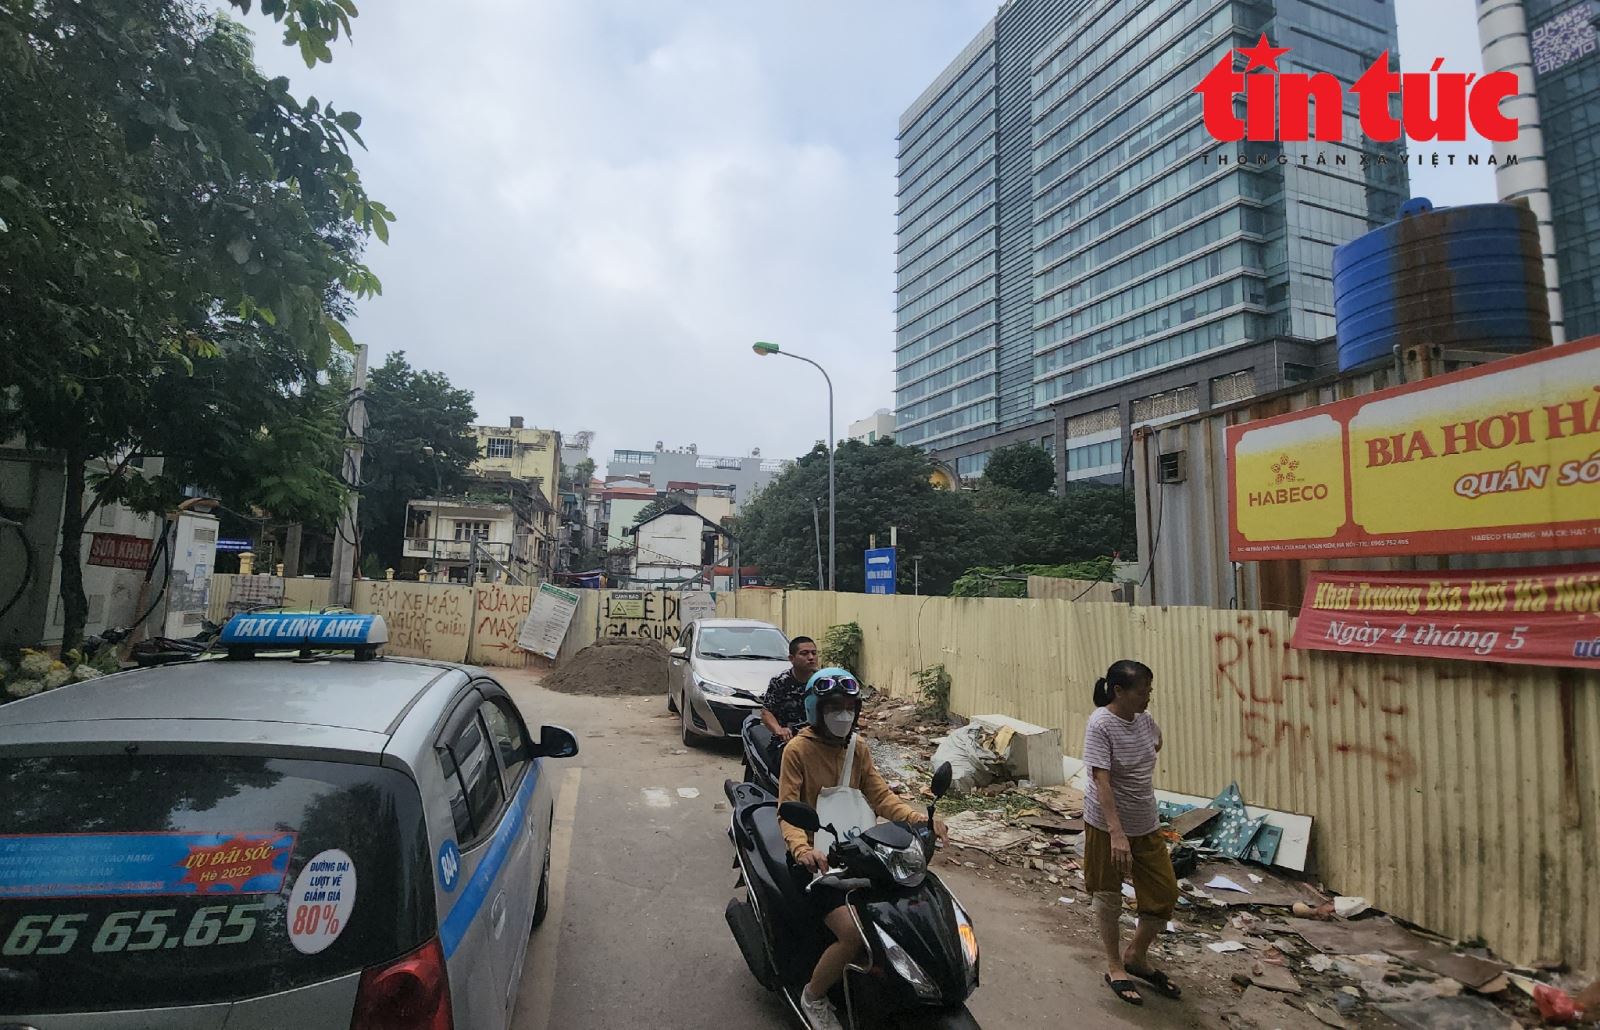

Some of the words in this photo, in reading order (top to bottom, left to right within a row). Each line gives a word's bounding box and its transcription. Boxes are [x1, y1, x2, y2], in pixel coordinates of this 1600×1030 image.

[1365, 429, 1438, 468] BIA
[1440, 408, 1536, 457] HƠI
[1454, 460, 1551, 499] QUÁN
[1249, 483, 1328, 507] HABECO
[402, 591, 424, 611] XE
[511, 593, 530, 616] XE
[1312, 582, 1355, 609] Khai
[1425, 580, 1463, 611] Bia
[1513, 577, 1548, 611] Hà
[233, 618, 275, 638] TAXI
[278, 618, 323, 638] LINH
[323, 618, 365, 638] ANH
[1325, 620, 1387, 646] Ngày
[1391, 623, 1407, 644] 4
[1412, 623, 1500, 655] tháng
[1505, 626, 1529, 650] 5
[200, 870, 217, 881] Hè
[221, 865, 252, 879] 2022
[310, 860, 335, 872] ĐƯỜNG
[310, 876, 330, 889] LƯỢT
[304, 888, 326, 901] GIẢM
[327, 889, 341, 901] GIÁ
[2, 913, 88, 955] 65
[92, 903, 265, 952] 65.65
[292, 904, 340, 935] 80%
